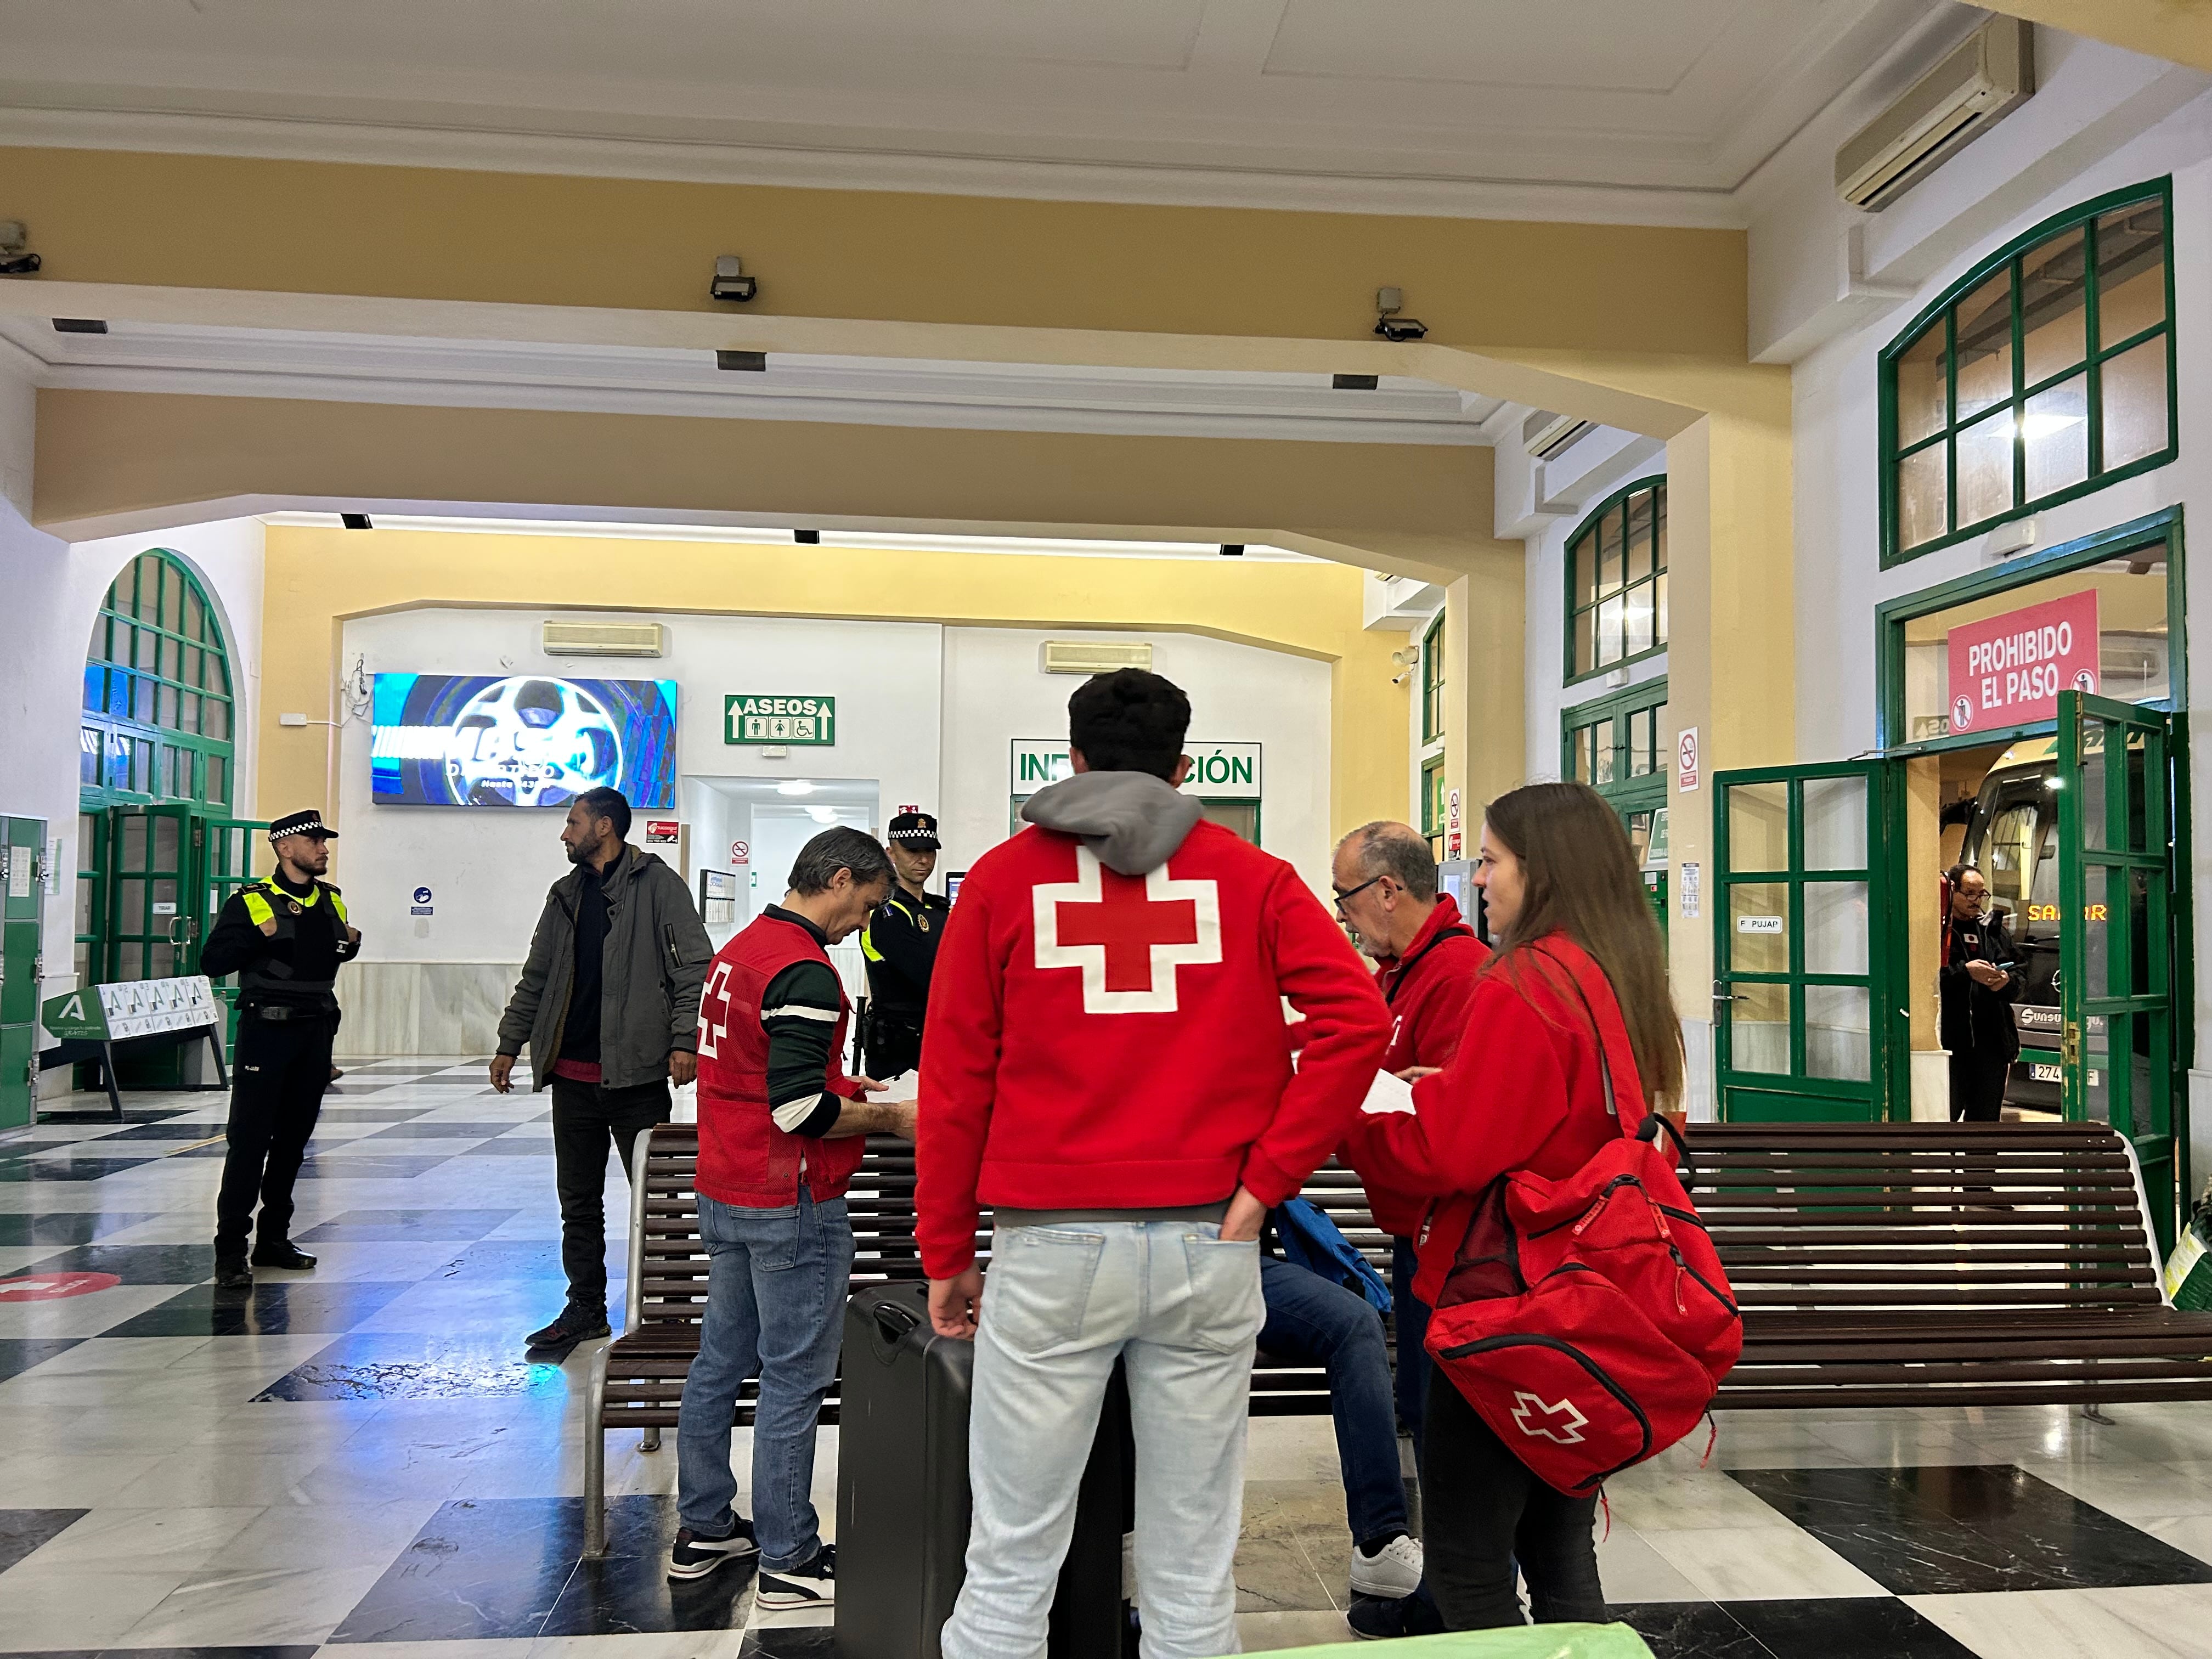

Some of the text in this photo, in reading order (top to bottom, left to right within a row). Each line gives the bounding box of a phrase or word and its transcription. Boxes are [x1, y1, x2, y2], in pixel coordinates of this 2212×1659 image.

[1969, 621, 2072, 676] PROHIBIDO
[743, 698, 817, 715] ASEOS
[1982, 663, 2058, 709] EL PASO
